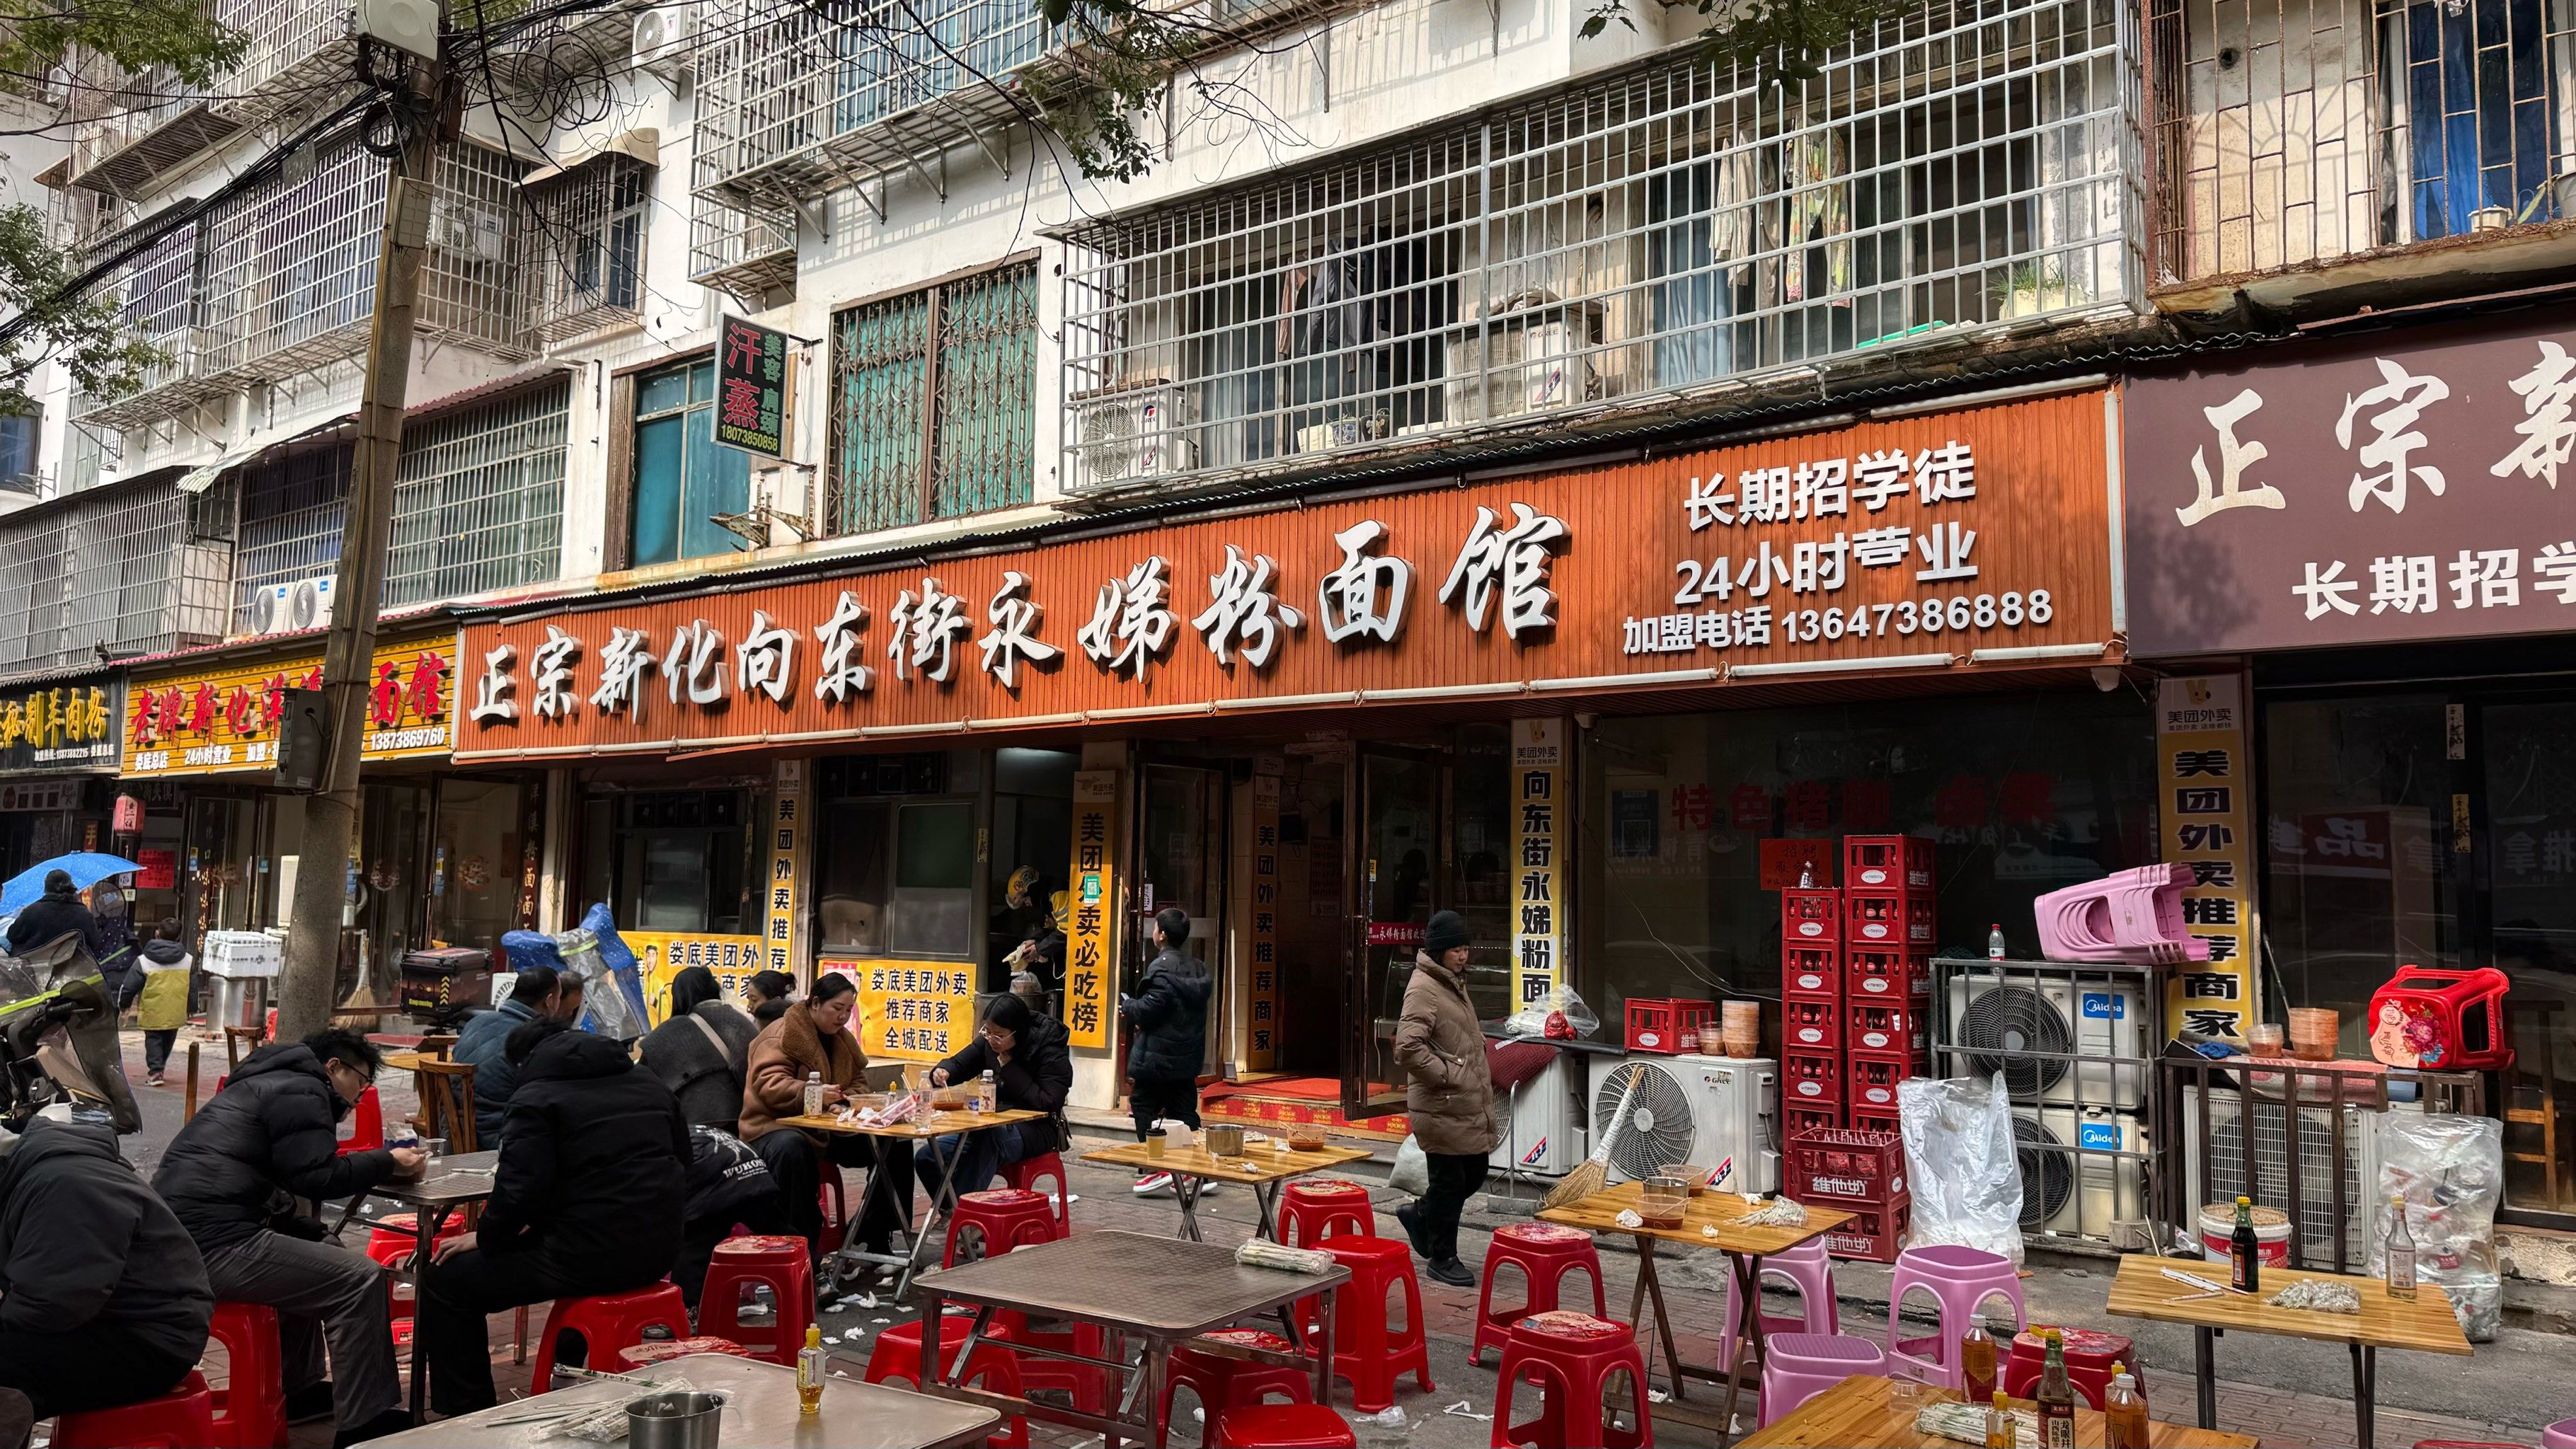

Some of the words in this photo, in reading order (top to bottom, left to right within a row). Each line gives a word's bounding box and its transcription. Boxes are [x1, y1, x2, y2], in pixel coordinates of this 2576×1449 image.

[723, 323, 761, 430] 汗蒸
[763, 334, 782, 383] 美容
[760, 388, 778, 436] 肩颈
[721, 424, 778, 451] 18073850858
[1684, 439, 1977, 531] 长期招学徒
[1674, 521, 1979, 604] 24小时营业
[469, 501, 1567, 724] 正宗新化向东街永娣粉面馆
[1623, 605, 1771, 654] 加盟电话
[1781, 589, 2052, 643] 13647386888
[2168, 708, 2231, 724] 美团外卖
[135, 751, 169, 771] 娄底总店
[185, 745, 232, 766] 24小时营业
[371, 727, 444, 751] 13873869760
[1517, 746, 1558, 758] 美团外卖
[1522, 771, 1552, 1012] 向东街永娣粉面
[2175, 750, 2241, 1037] 美团外卖推荐商家
[669, 942, 759, 969] 娄底美团外
[1254, 826, 1275, 1052] 美团外卖推荐商家
[871, 969, 967, 996] 娄底美团外卖
[886, 998, 949, 1024] 推荐商家
[885, 1026, 948, 1053] 全城配送
[1813, 1177, 1866, 1196] 維他奶
